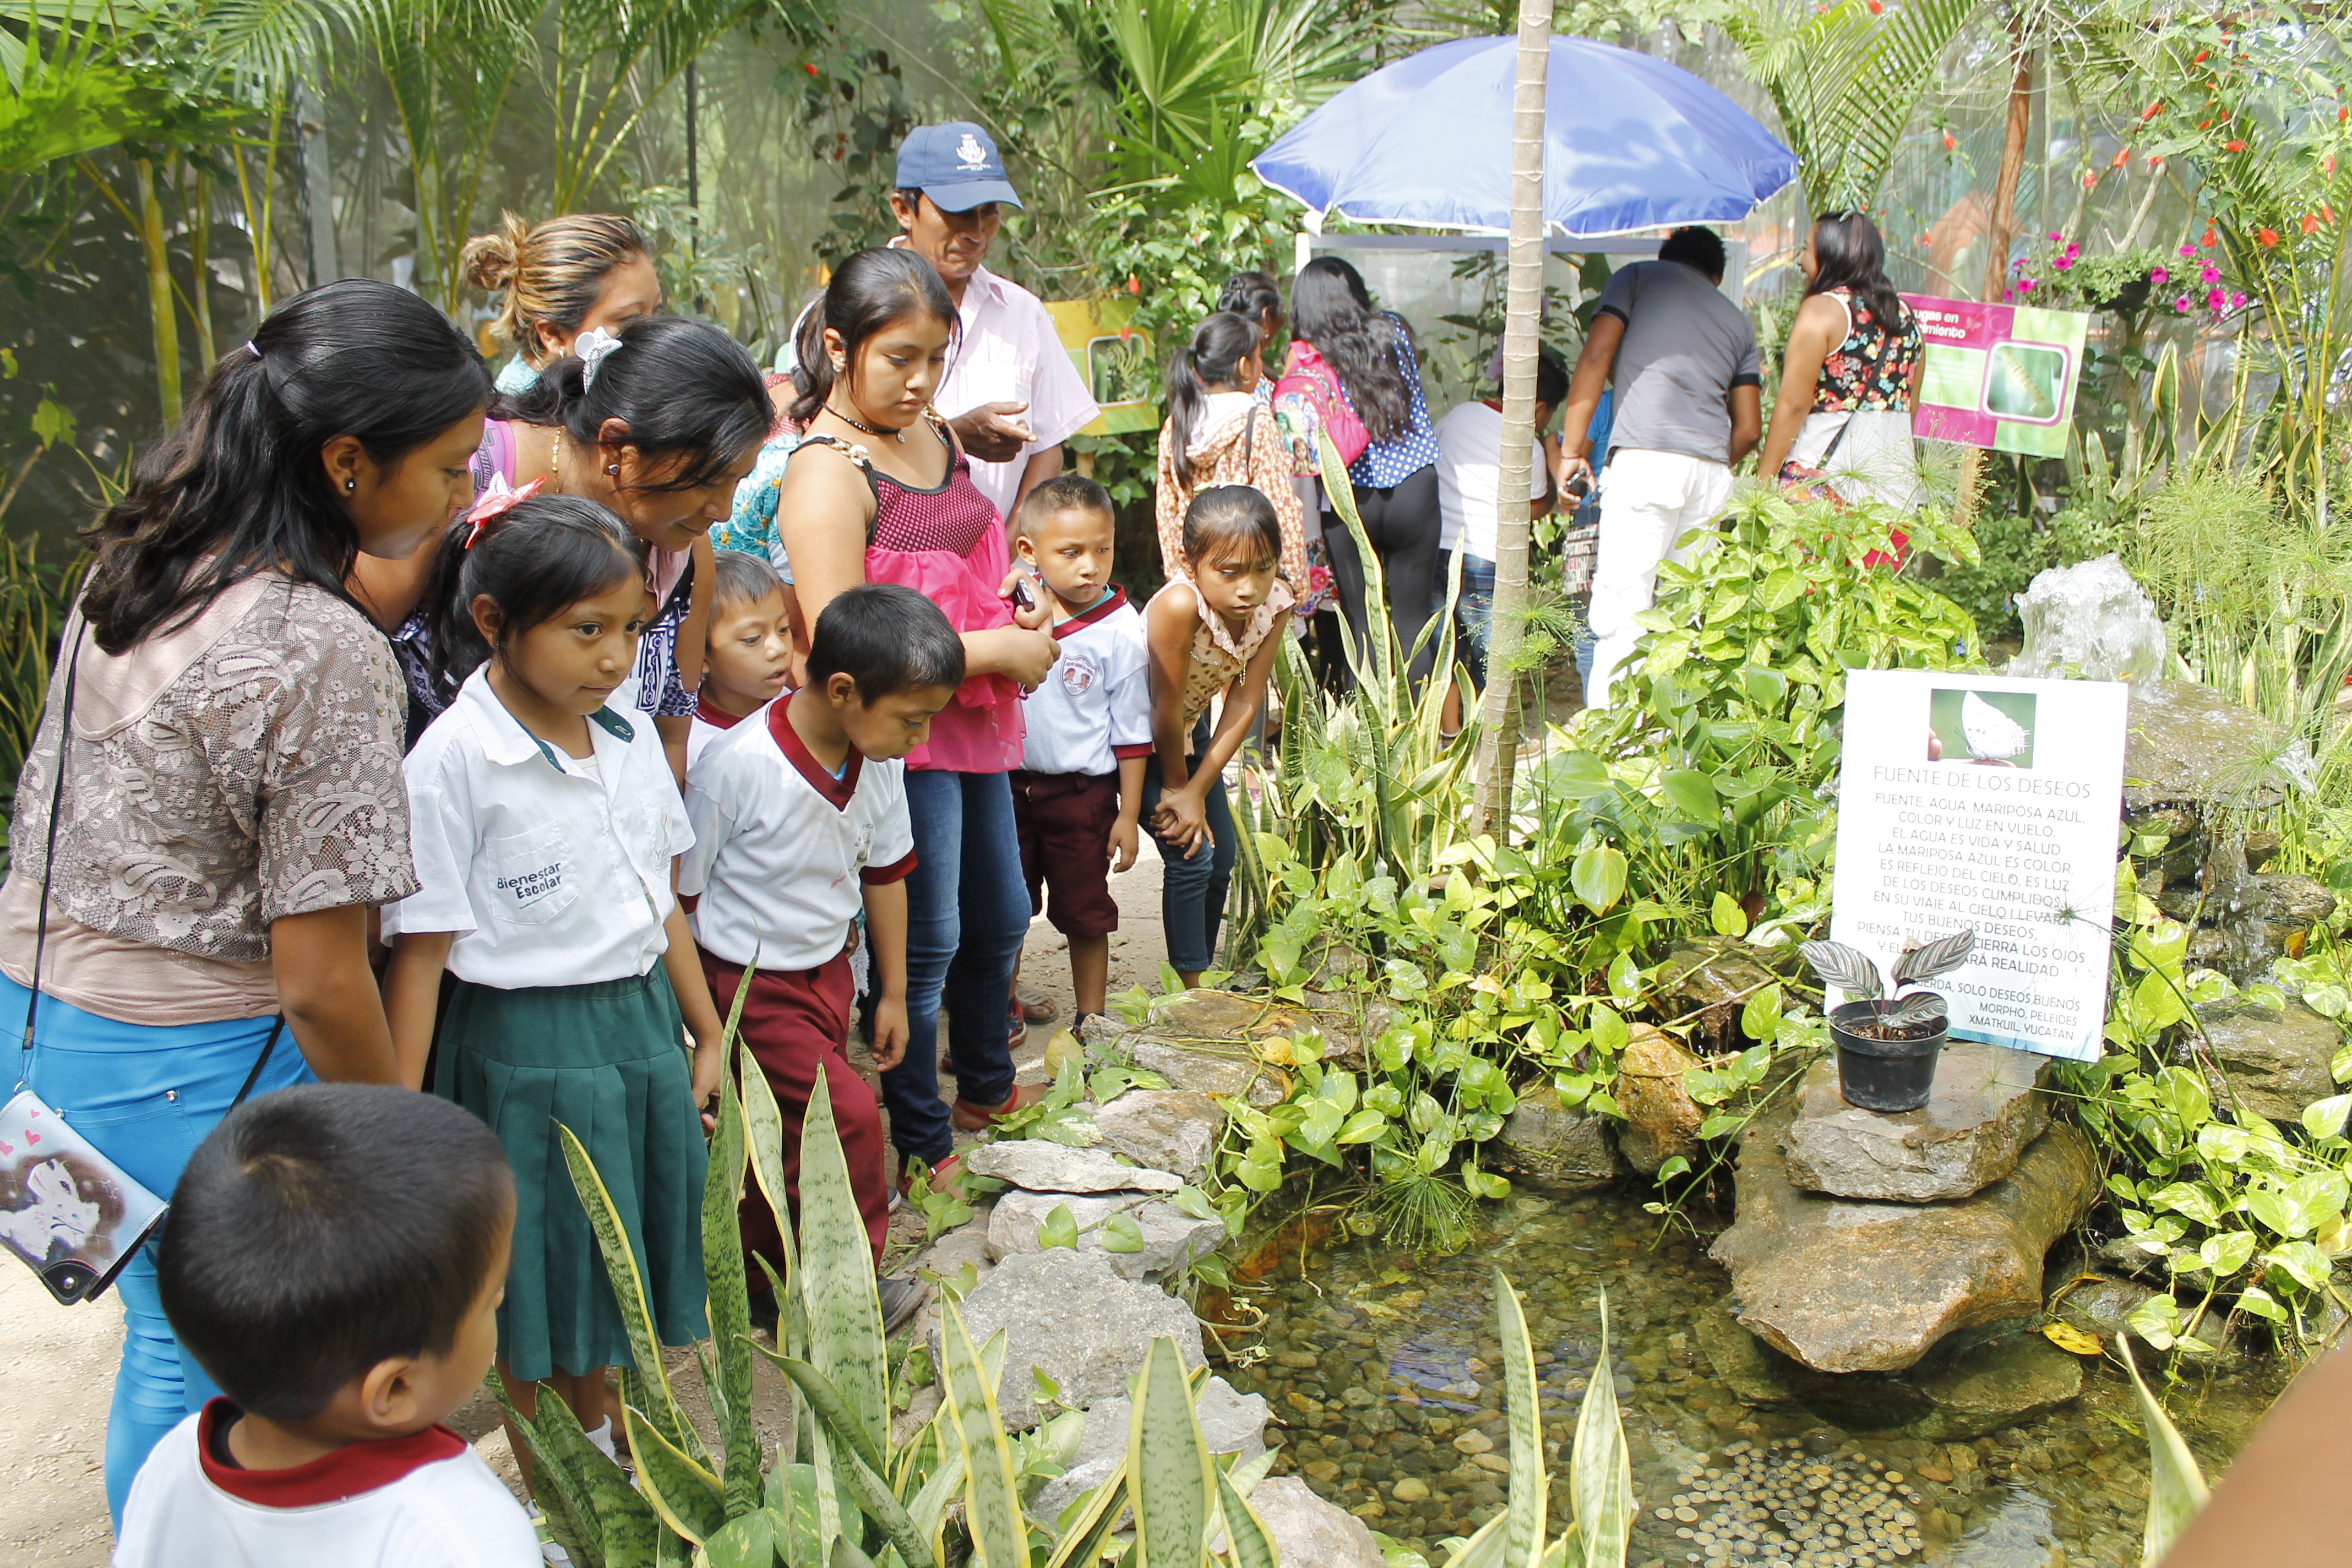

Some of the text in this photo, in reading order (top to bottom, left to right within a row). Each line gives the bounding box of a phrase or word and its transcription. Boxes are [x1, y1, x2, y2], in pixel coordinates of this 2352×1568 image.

[1943, 313, 1959, 324] en
[1874, 766, 2090, 798] FUENTE DE LOS DESEOS
[1875, 793, 1925, 808] FUENTE,
[1973, 802, 2042, 819] MARIPOSA
[2047, 809, 2085, 824] AZUL,
[1899, 812, 2055, 837] COLOR Y LUZ EN VUELO.
[1893, 827, 2060, 855] EL AGUA ES VIDA Y SALUD
[1879, 842, 2074, 875] LA MARIPOSA AZUL ES COLOR,
[497, 862, 561, 889] Bienestar
[516, 875, 562, 899] Escolar
[1880, 859, 2070, 891] ES REFLEJO DEL CIELO, ES LUZ
[1883, 875, 1899, 888] DE
[1903, 878, 1925, 890] LOS
[1930, 881, 1978, 897] DESEOS
[1874, 891, 1890, 902] EN
[1894, 894, 1909, 905] SU
[1913, 896, 1945, 910] VIAJE
[1948, 901, 1964, 913] AL
[1969, 903, 2006, 918] CIELO
[1902, 911, 1924, 923] TUS
[1929, 914, 1980, 931] BUENOS
[1858, 922, 1900, 937] PIENSA
[1905, 928, 1920, 940] TU
[1974, 937, 2018, 954] CIERRA
[2023, 944, 2048, 958] LOS
[2052, 949, 2085, 963] OJOS
[1878, 940, 1885, 951] Y
[1991, 956, 2059, 977] REALIDAD
[1958, 982, 1986, 997] SOLO
[2034, 994, 2081, 1011] BUENOS
[1969, 1014, 2075, 1041] XMATKUIL, YUCATÁN.
[1979, 1003, 2077, 1026] MORPHO, PELEIDES
